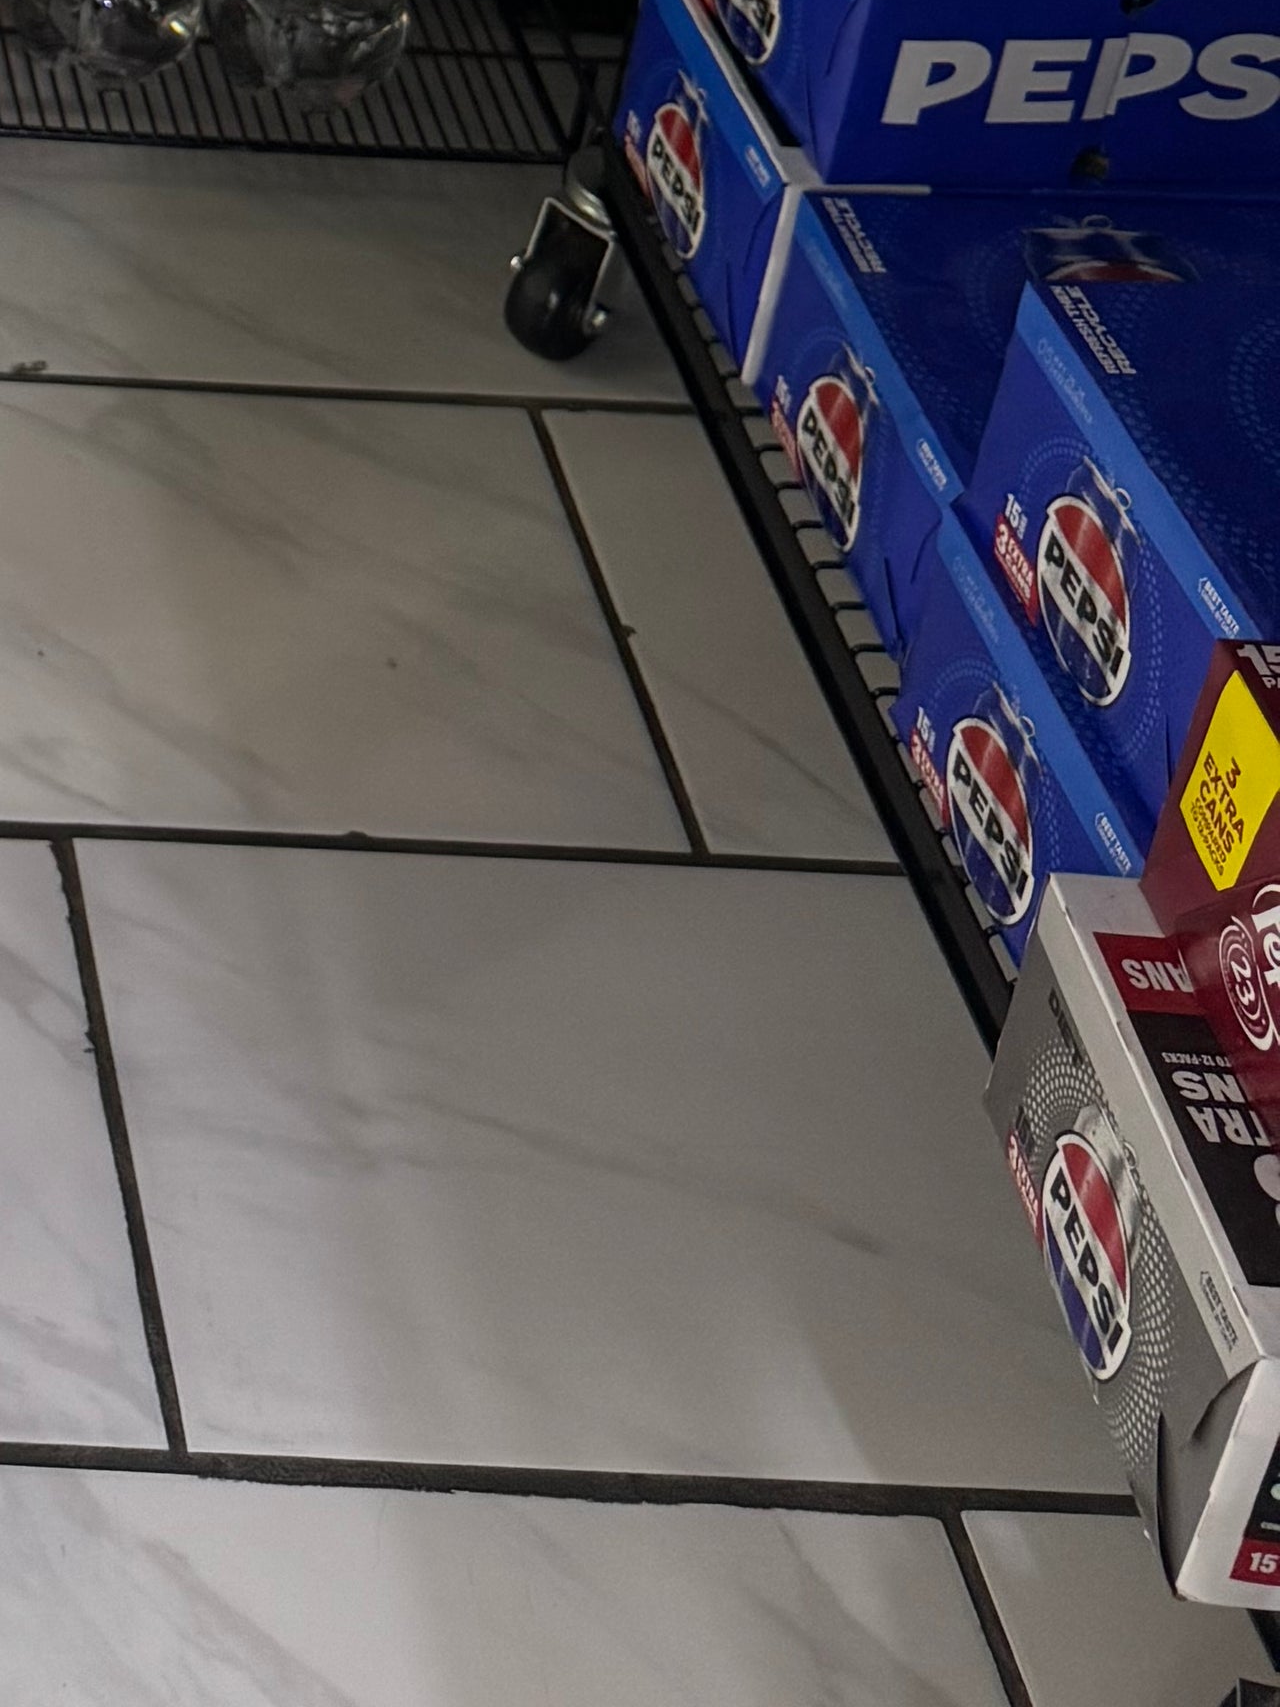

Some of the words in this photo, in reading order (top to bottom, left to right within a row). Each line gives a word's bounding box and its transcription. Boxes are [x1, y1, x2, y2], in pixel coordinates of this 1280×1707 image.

[652, 134, 701, 236] PEPSI
[801, 405, 857, 528] PEPSI
[1004, 493, 1022, 529] 15
[1044, 530, 1125, 680] PEPSI
[1198, 779, 1234, 854] CANS
[1202, 750, 1245, 845] EXTRA
[1225, 756, 1242, 790] 3
[952, 748, 1030, 901] PEPSI
[1230, 956, 1257, 1007] 23
[1050, 1164, 1125, 1357] PEPSI
[1249, 1551, 1280, 1575] 15
